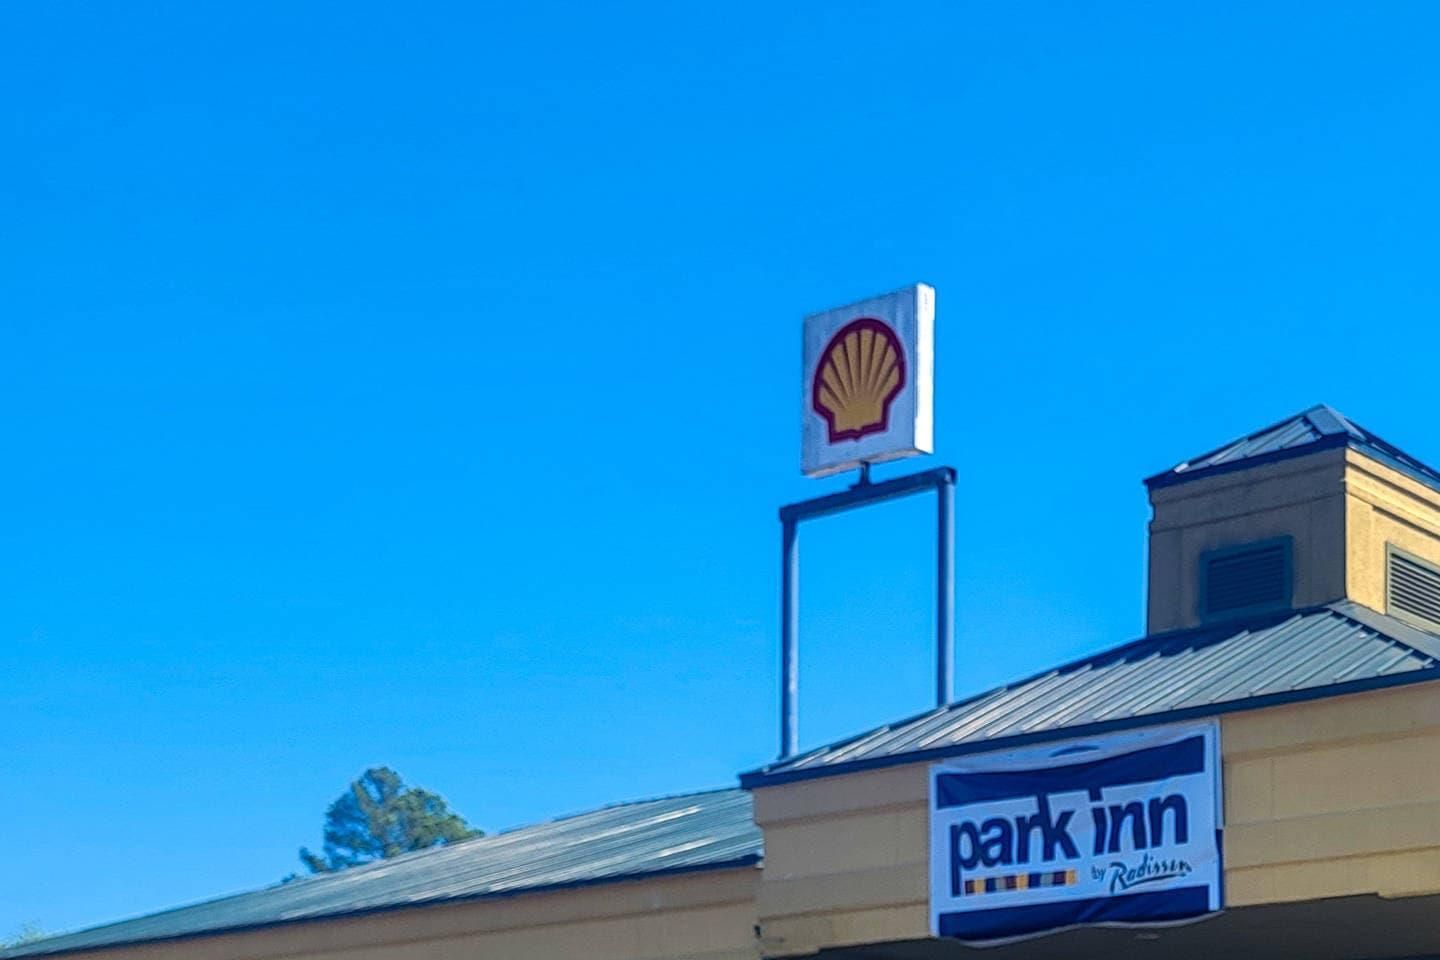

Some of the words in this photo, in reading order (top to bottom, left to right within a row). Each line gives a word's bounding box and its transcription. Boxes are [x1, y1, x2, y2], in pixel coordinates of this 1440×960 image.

[950, 793, 1080, 897] park
[1088, 787, 1189, 857] inn
[1090, 864, 1106, 881] by
